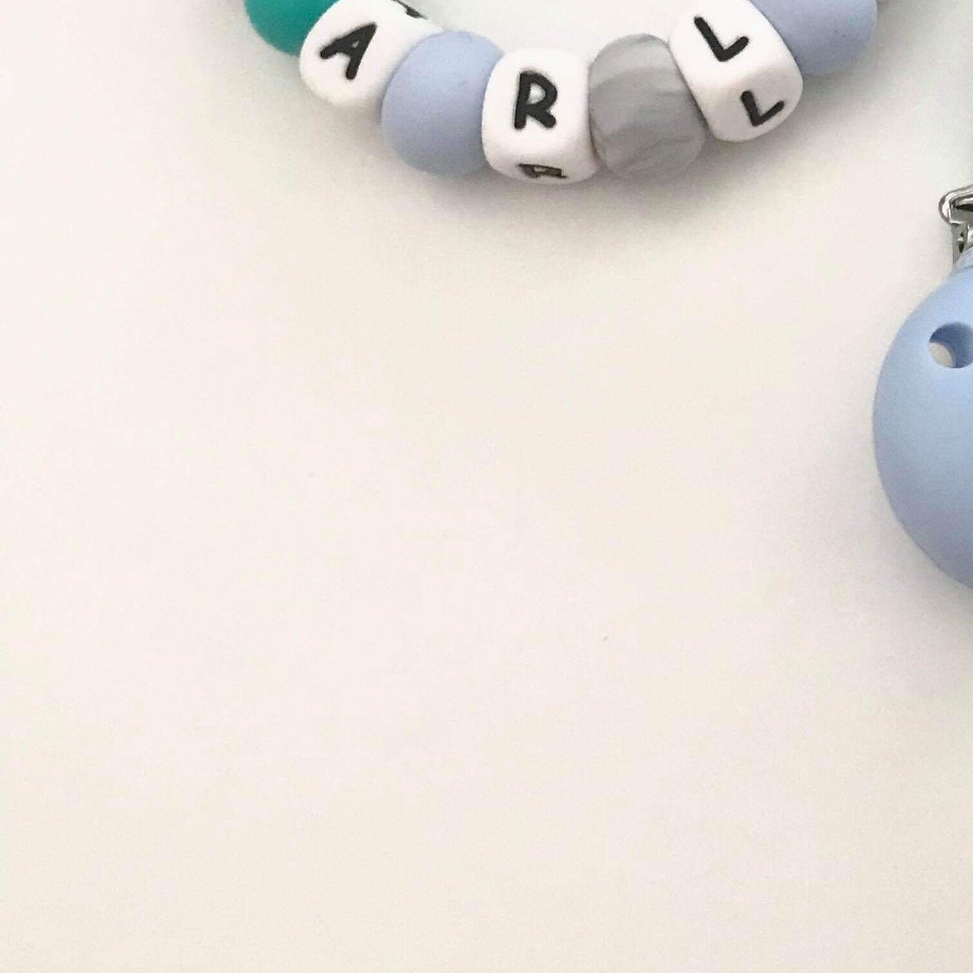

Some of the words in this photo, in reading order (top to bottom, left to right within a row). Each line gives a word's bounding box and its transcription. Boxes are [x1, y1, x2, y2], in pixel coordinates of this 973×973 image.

[319, 23, 377, 80] A
[513, 71, 559, 130] R
[693, 16, 749, 63] L
[740, 90, 785, 127] L
